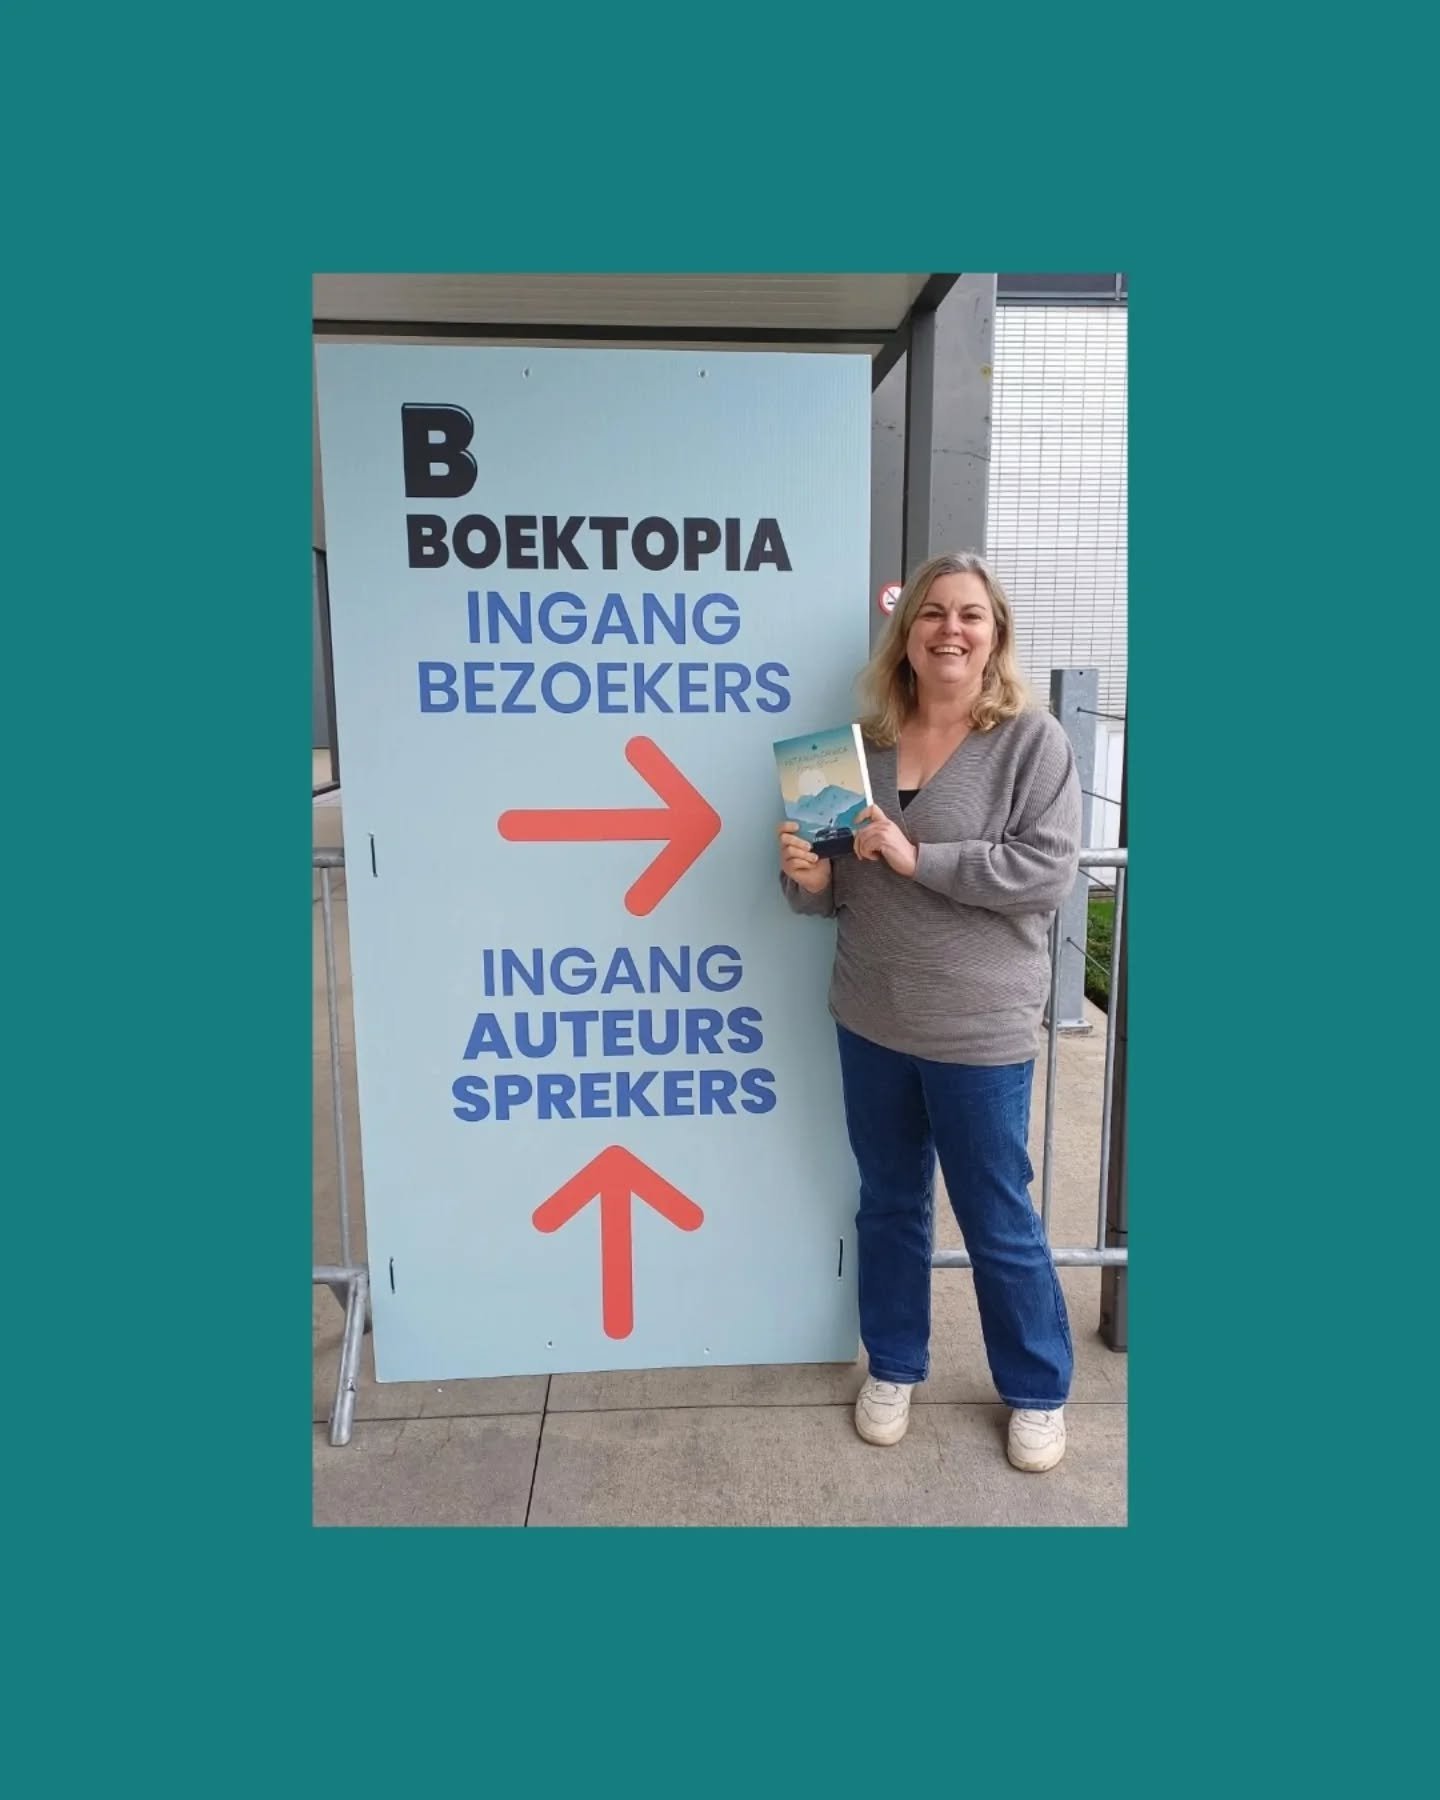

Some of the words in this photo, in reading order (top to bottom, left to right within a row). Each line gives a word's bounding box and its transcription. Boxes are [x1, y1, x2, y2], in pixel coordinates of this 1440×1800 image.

[401, 402, 478, 499] B
[406, 514, 793, 571] BOEKTOPIA
[467, 591, 741, 645] INGANG
[418, 662, 792, 714] BEZOEKERS
[483, 945, 743, 996] INGANG
[463, 1007, 764, 1060] AUTEURS
[451, 1068, 777, 1122] SPREKERS
